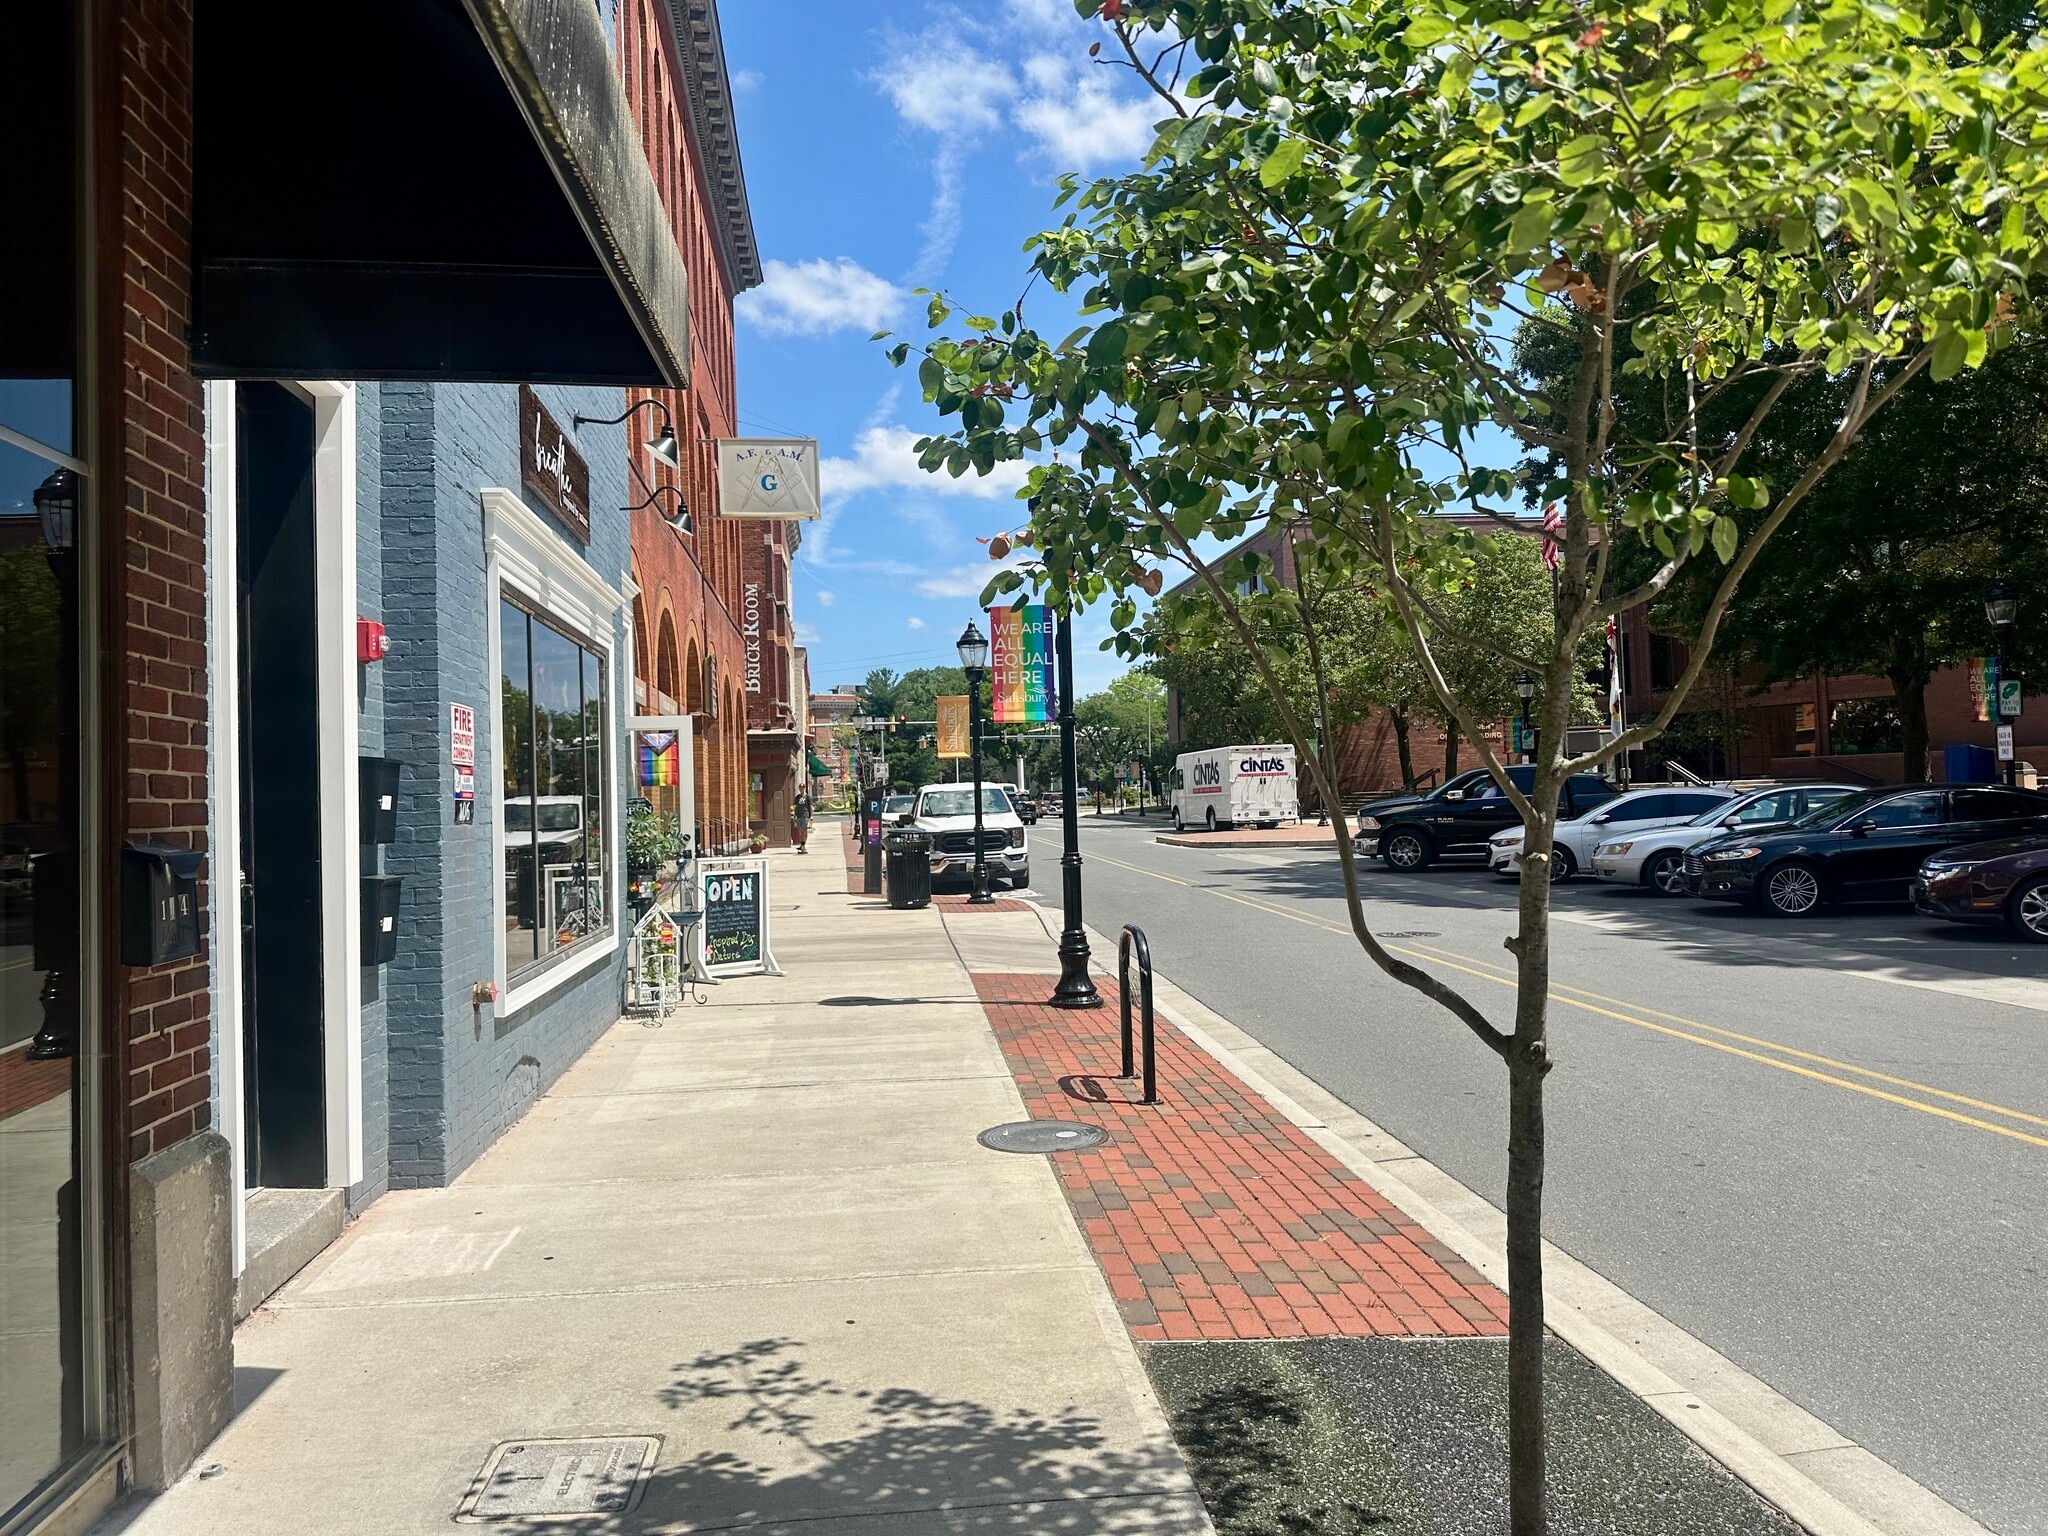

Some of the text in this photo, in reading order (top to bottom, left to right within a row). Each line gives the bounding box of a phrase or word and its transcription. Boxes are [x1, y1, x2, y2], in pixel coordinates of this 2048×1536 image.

[535, 412, 572, 506] breathe
[736, 448, 803, 462] A.F. & A.M.
[760, 474, 778, 491] G
[993, 622, 1052, 635] WE ARE
[743, 583, 761, 694] BRICK ROOM
[994, 637, 1026, 651] ALL
[993, 652, 1053, 668] EQUAL
[994, 670, 1043, 685] HERE
[1969, 666, 2000, 675] WE ARE
[1970, 683, 1997, 693] EQUA
[997, 691, 1051, 705] Salisbury
[1971, 694, 1997, 702] HERE
[454, 708, 471, 732] FIRE
[945, 703, 957, 751] Salisbury
[1193, 756, 1220, 785] CINTAS
[1240, 757, 1285, 772] CINTAS
[871, 801, 878, 812] P
[709, 879, 753, 901] OPEN
[711, 949, 741, 964] Nature
